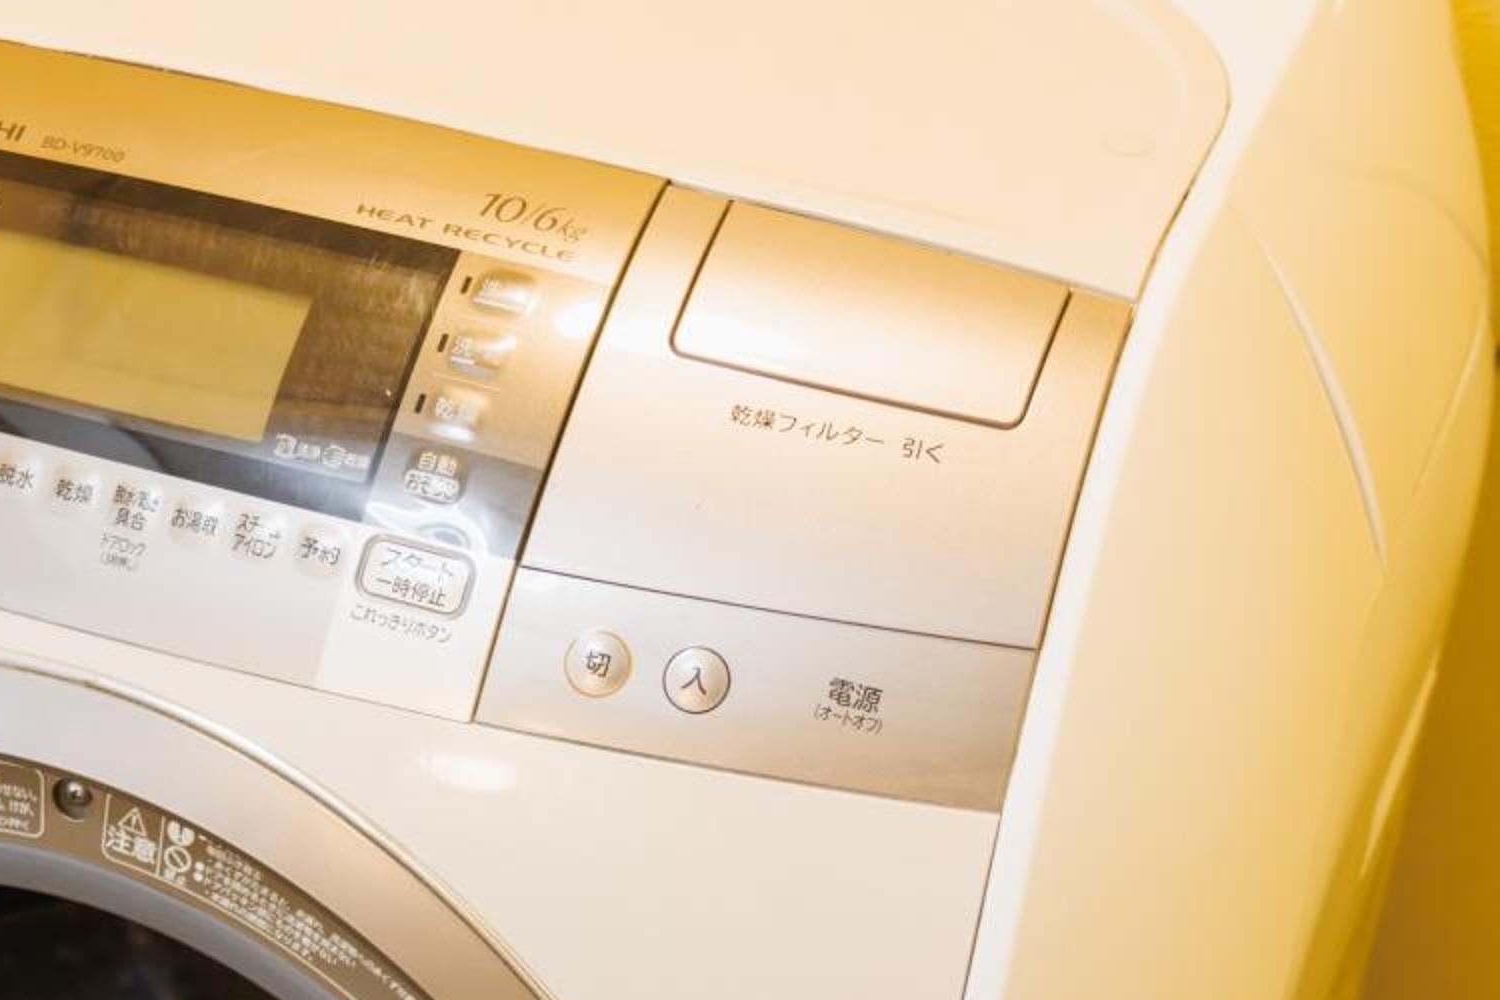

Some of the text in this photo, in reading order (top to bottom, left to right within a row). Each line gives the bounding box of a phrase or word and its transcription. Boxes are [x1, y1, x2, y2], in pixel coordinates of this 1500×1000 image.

[40, 134, 127, 163] BD-V9700
[355, 203, 578, 264] HEAT RECYCLE
[729, 404, 946, 464] 乾燥フィルター 引く
[417, 451, 458, 476] 自動
[54, 478, 95, 504] 乾燥
[115, 508, 149, 532] 具合
[231, 533, 278, 559] アイロン
[299, 537, 341, 566] 予約
[379, 547, 455, 578] スタート
[375, 576, 446, 608] 一時停止
[585, 651, 612, 678] 切
[680, 667, 708, 696] 入
[828, 677, 883, 714] 電源
